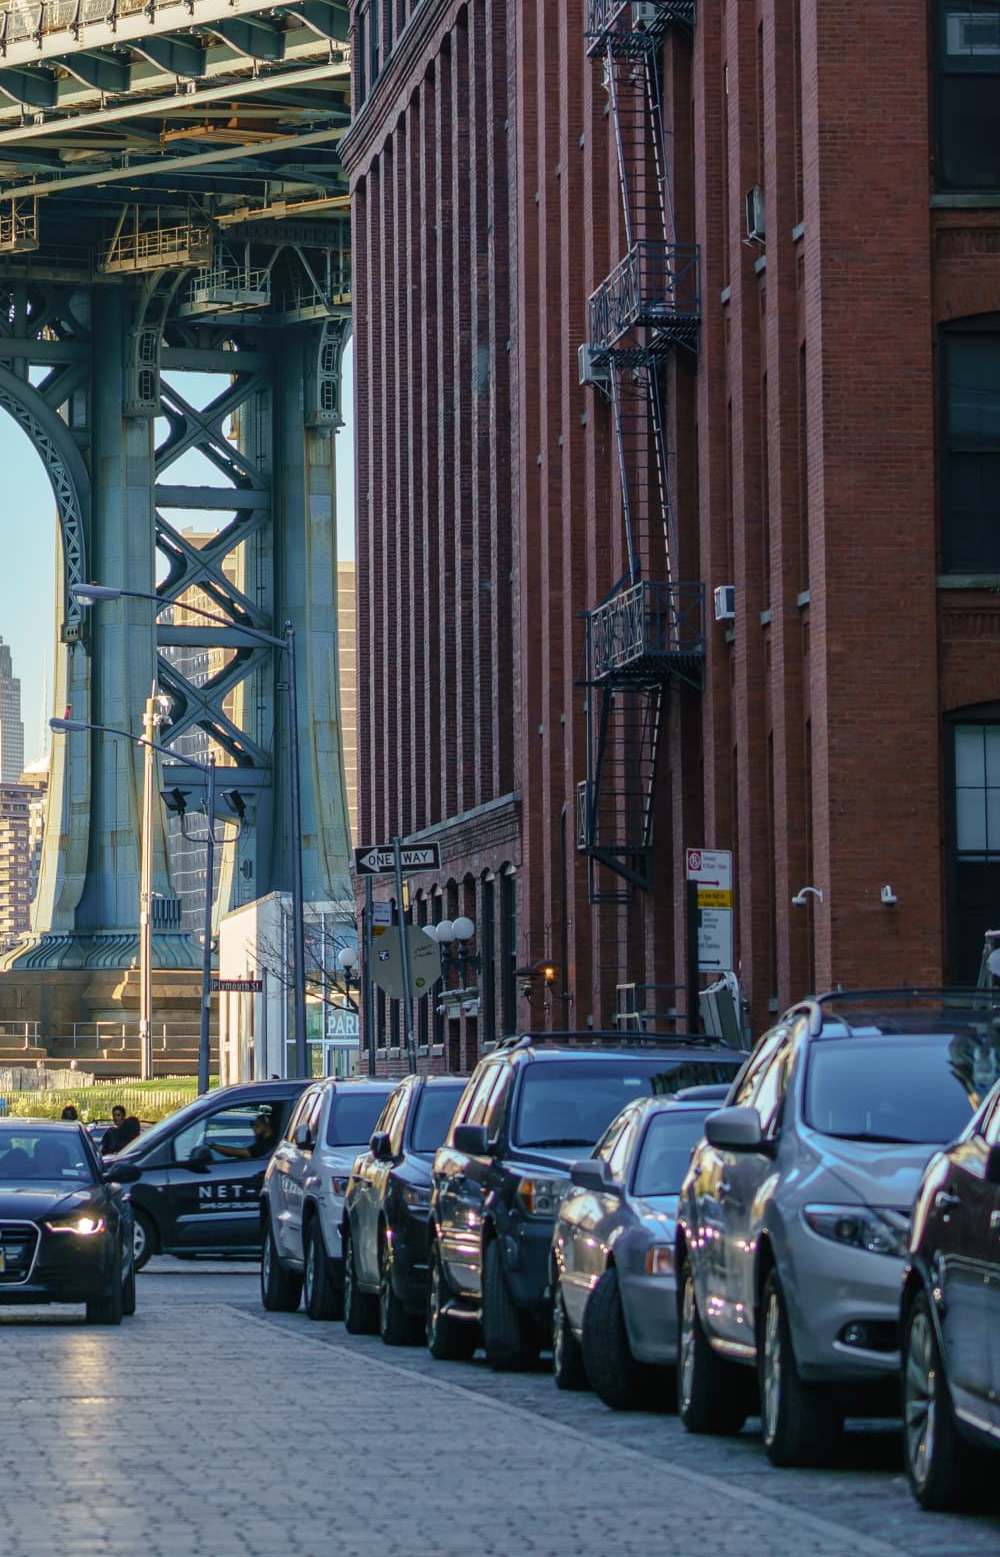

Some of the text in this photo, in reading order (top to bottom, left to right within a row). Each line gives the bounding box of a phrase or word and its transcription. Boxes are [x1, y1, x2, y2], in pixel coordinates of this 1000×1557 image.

[368, 851, 428, 866] ONE WAY
[213, 981, 249, 991] Plymouth
